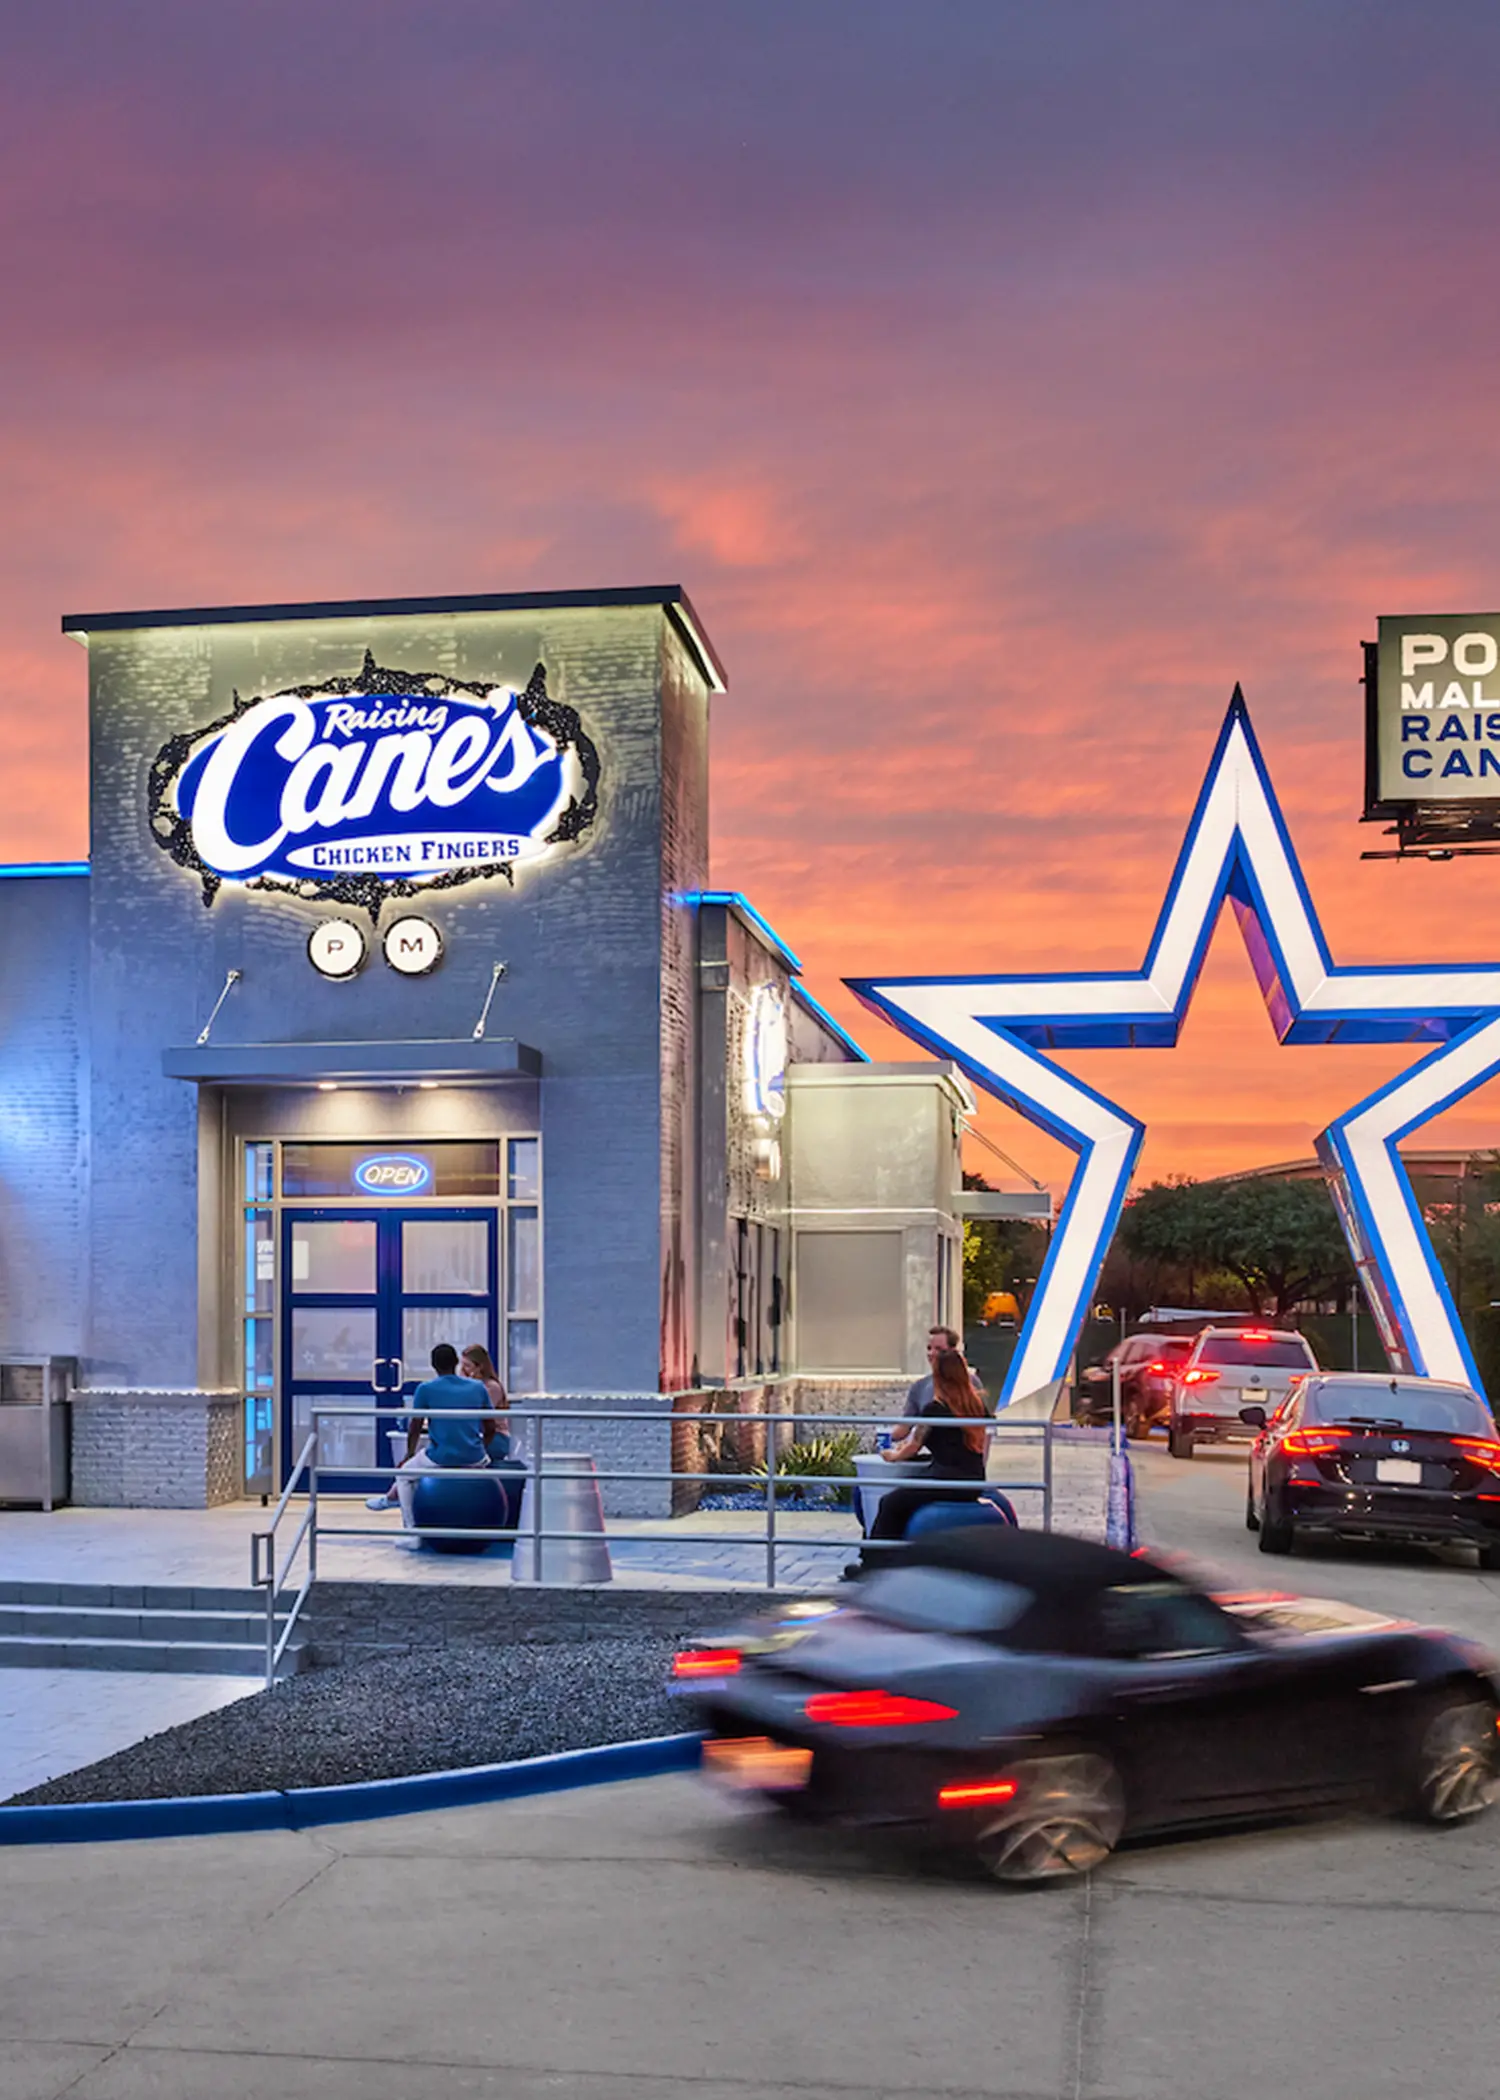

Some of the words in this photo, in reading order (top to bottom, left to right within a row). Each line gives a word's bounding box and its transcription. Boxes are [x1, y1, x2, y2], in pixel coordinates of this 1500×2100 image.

[1401, 632, 1498, 676] PO
[1401, 681, 1500, 710] MAL
[322, 699, 449, 739] Raising
[191, 686, 556, 872] Cane's
[312, 844, 412, 867] CHICKEN
[420, 839, 520, 862] FINGERS
[327, 939, 344, 955] P
[400, 937, 424, 953] M
[364, 1165, 422, 1185] OPEN
